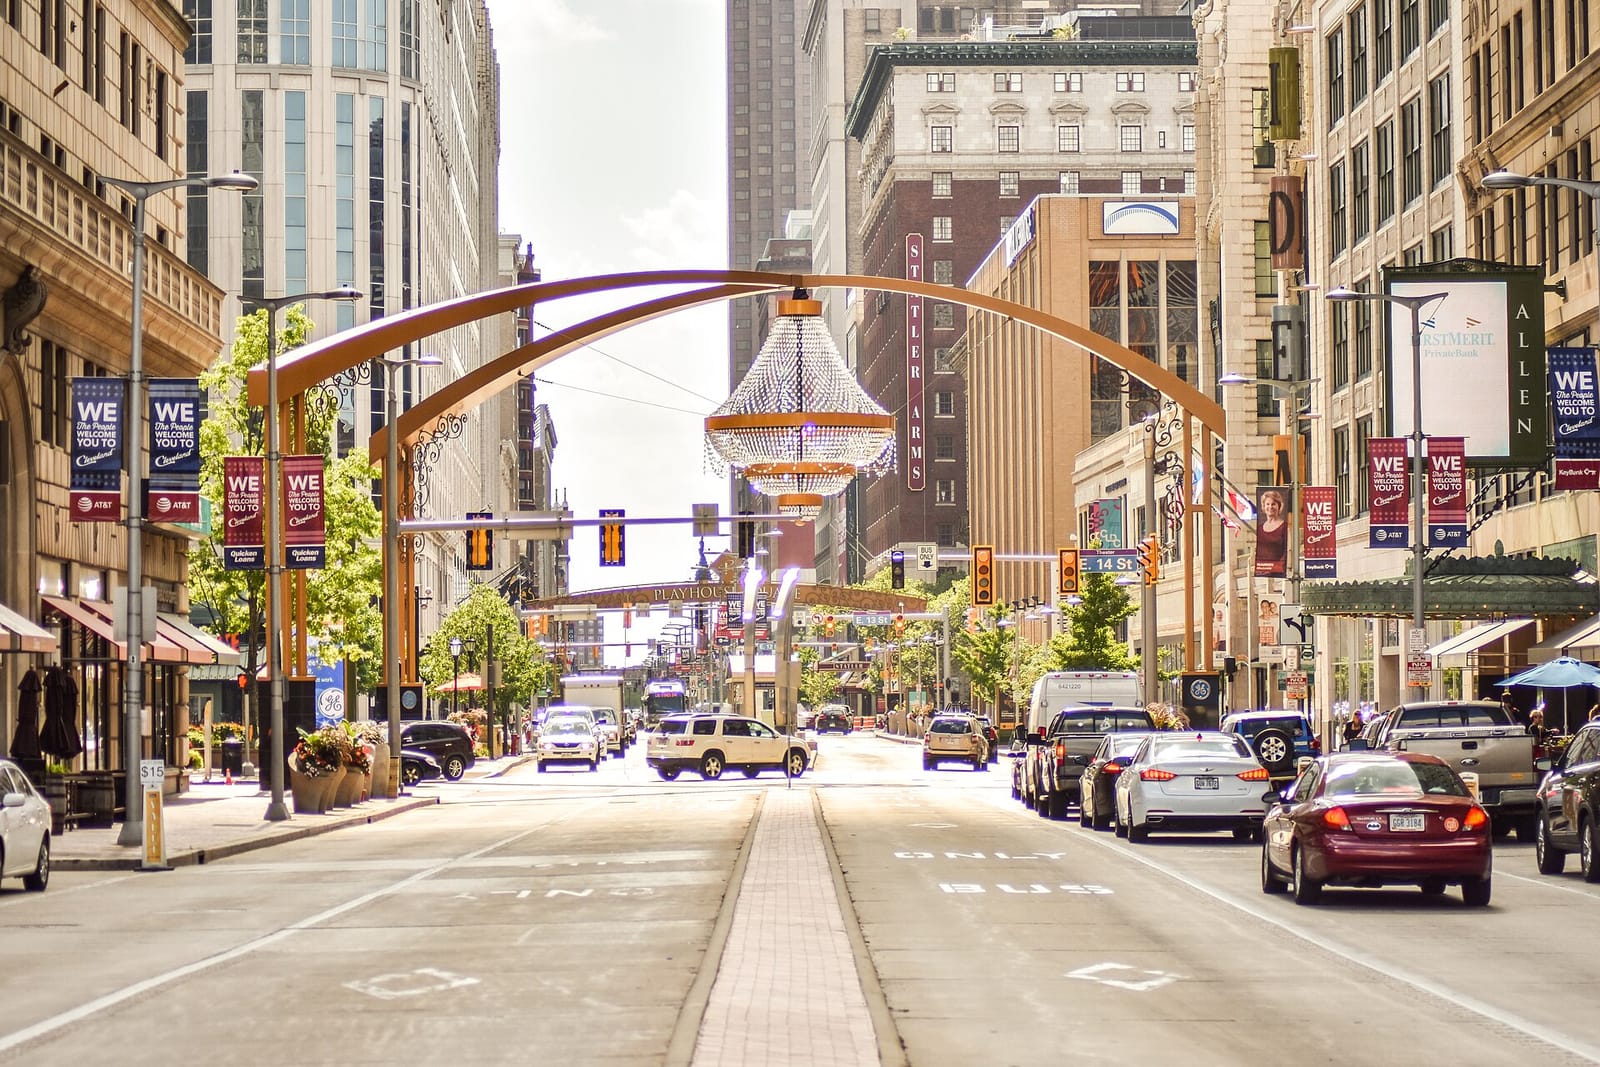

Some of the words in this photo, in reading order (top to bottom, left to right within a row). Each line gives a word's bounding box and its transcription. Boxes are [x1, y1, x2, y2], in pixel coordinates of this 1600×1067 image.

[910, 245, 921, 379] STTLER
[1424, 349, 1479, 358] PrivateBank
[1515, 303, 1532, 434] ALLEN
[1554, 371, 1594, 390] WE
[1556, 391, 1570, 399] The
[1571, 391, 1594, 400] People
[77, 402, 118, 422] WE
[154, 402, 194, 422] WE
[1557, 406, 1579, 415] YOU
[1581, 406, 1595, 415] TO
[76, 422, 91, 430] The
[92, 422, 116, 431] People
[154, 423, 168, 431] The
[170, 423, 194, 432] People
[1559, 416, 1593, 435] Cleveland
[76, 431, 116, 439] WELCOME
[155, 431, 194, 439] WELCOME
[76, 438, 101, 448] YOU
[101, 438, 116, 448] TO
[155, 439, 179, 448] YOU
[179, 439, 194, 448] TO
[911, 405, 922, 480] ARMS
[75, 449, 114, 467] Cleveland
[154, 449, 192, 468] Cleveland
[1431, 456, 1462, 471] WE
[1373, 457, 1404, 472] WE
[228, 476, 259, 491] WE
[288, 475, 320, 490] WE
[93, 501, 113, 509] AT&T
[172, 501, 192, 509] AT&T
[228, 504, 247, 512] YOU
[248, 504, 259, 512] TO
[289, 503, 307, 511] YOU
[309, 503, 320, 511] TO
[1306, 502, 1332, 515] WE
[920, 546, 933, 554] BUS
[1079, 558, 1092, 570] E.
[1096, 558, 1113, 570] 14
[1116, 557, 1133, 570] St
[728, 600, 742, 608] WE
[866, 616, 877, 624] 13
[878, 616, 888, 624] St
[141, 766, 164, 778] $15
[893, 852, 1067, 860] ONLY
[938, 883, 1115, 895] BUS
